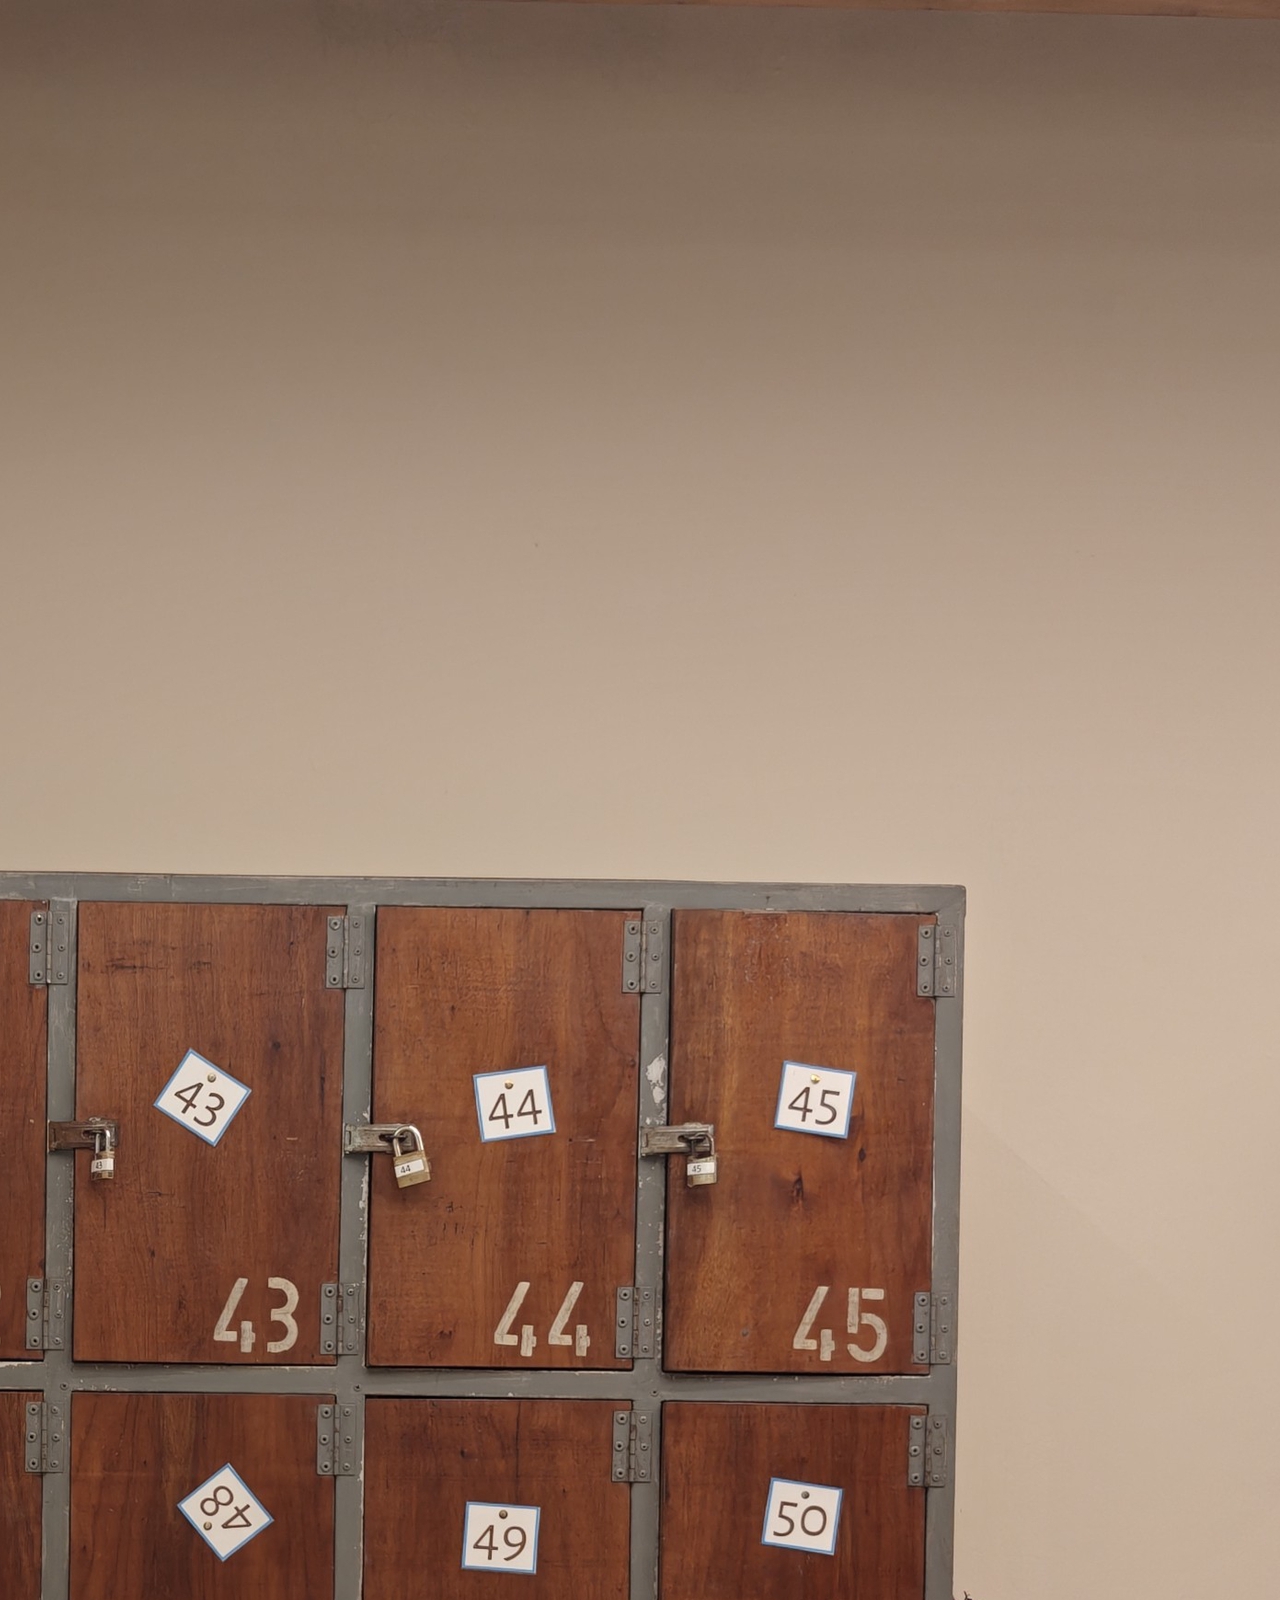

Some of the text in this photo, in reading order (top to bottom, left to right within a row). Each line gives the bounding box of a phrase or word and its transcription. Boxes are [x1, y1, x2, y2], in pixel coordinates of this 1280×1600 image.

[174, 1081, 224, 1126] 43
[489, 1088, 542, 1129] 44
[788, 1086, 840, 1125] 45
[214, 1277, 299, 1353] 43
[494, 1282, 590, 1356] 44
[793, 1286, 887, 1362] 45
[200, 1486, 252, 1530] 48
[773, 1501, 827, 1536] 50
[473, 1525, 526, 1561] 49
